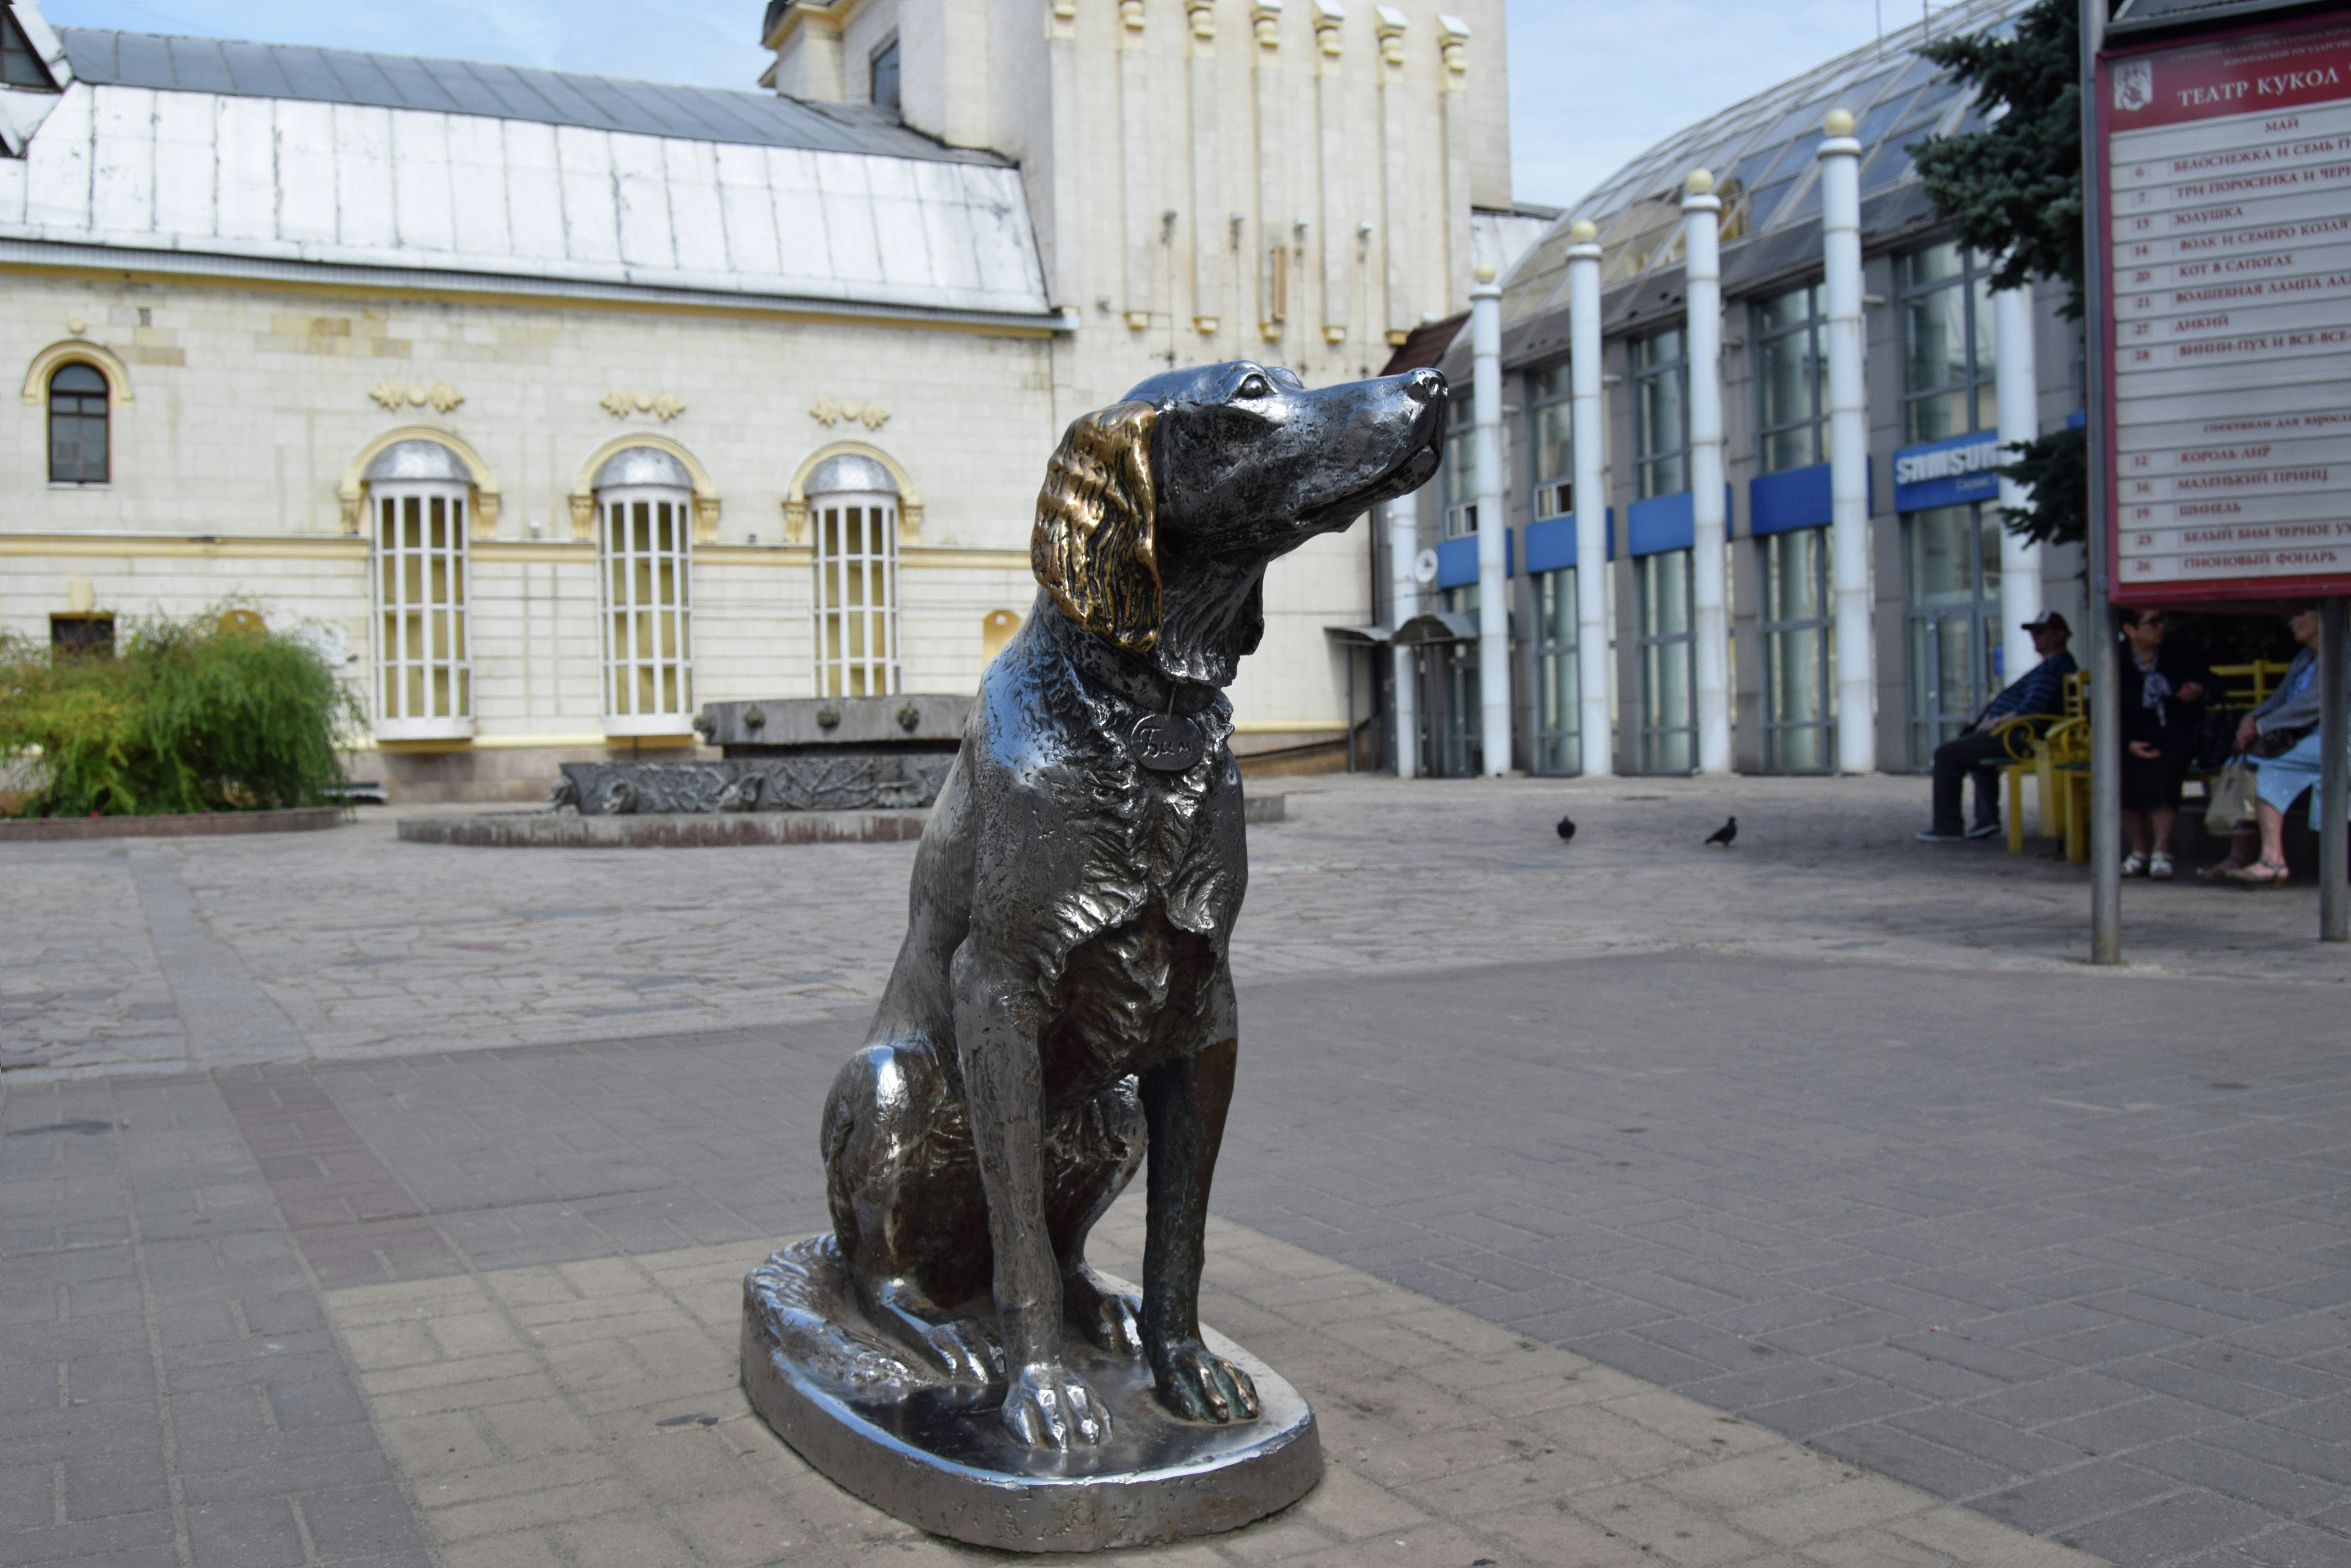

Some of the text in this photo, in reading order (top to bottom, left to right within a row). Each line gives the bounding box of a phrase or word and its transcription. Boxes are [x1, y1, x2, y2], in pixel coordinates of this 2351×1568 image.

[2177, 66, 2339, 106] ТЕАТР КУКОЛ
[2265, 116, 2299, 133] МАЙ
[2174, 150, 2272, 172] БЕЛОСНЕЖКА
[2277, 146, 2288, 158] И
[2293, 140, 2333, 156] СЕМЬ
[2177, 184, 2204, 198] ТРИ
[2209, 172, 2298, 193] ПОРОСЕНКА
[2303, 169, 2315, 181] И
[2136, 206, 2243, 230] 13 ЗОЛУШКА
[2135, 217, 2351, 257] 14 ВОЛК И СЕМЕРО КОЗЛЯ
[2179, 263, 2207, 277] КОТ
[2213, 262, 2221, 273] В
[2225, 253, 2293, 272] САПОГАХ
[2137, 296, 2150, 309] 21
[2176, 282, 2263, 304] ВОЛШЕБНАЯ
[2268, 276, 2321, 295] ЛАМПА
[2136, 323, 2149, 336] 27
[2179, 336, 2267, 356] ВИННИ-ПУХ
[2273, 336, 2284, 347] И
[2203, 420, 2272, 433] спектакли
[2276, 416, 2300, 428] для
[1896, 440, 1998, 485] SAMSUN
[2134, 444, 2271, 466] 12 КОРОЛЬ ЛИР
[2177, 471, 2269, 489] МАЛЕНЬКИЙ
[2274, 468, 2328, 483] ПРИНЦ
[2179, 501, 2242, 516] ШИНЕЛЬ
[2139, 533, 2152, 545] 23
[2183, 526, 2233, 543] БЕЛЫЙ
[2238, 526, 2271, 539] БИМ
[2275, 522, 2331, 538] ЧЕРНОЕ
[2183, 550, 2271, 569] ПИОНОВЫЙ
[2275, 550, 2337, 565] ФОНАРЬ
